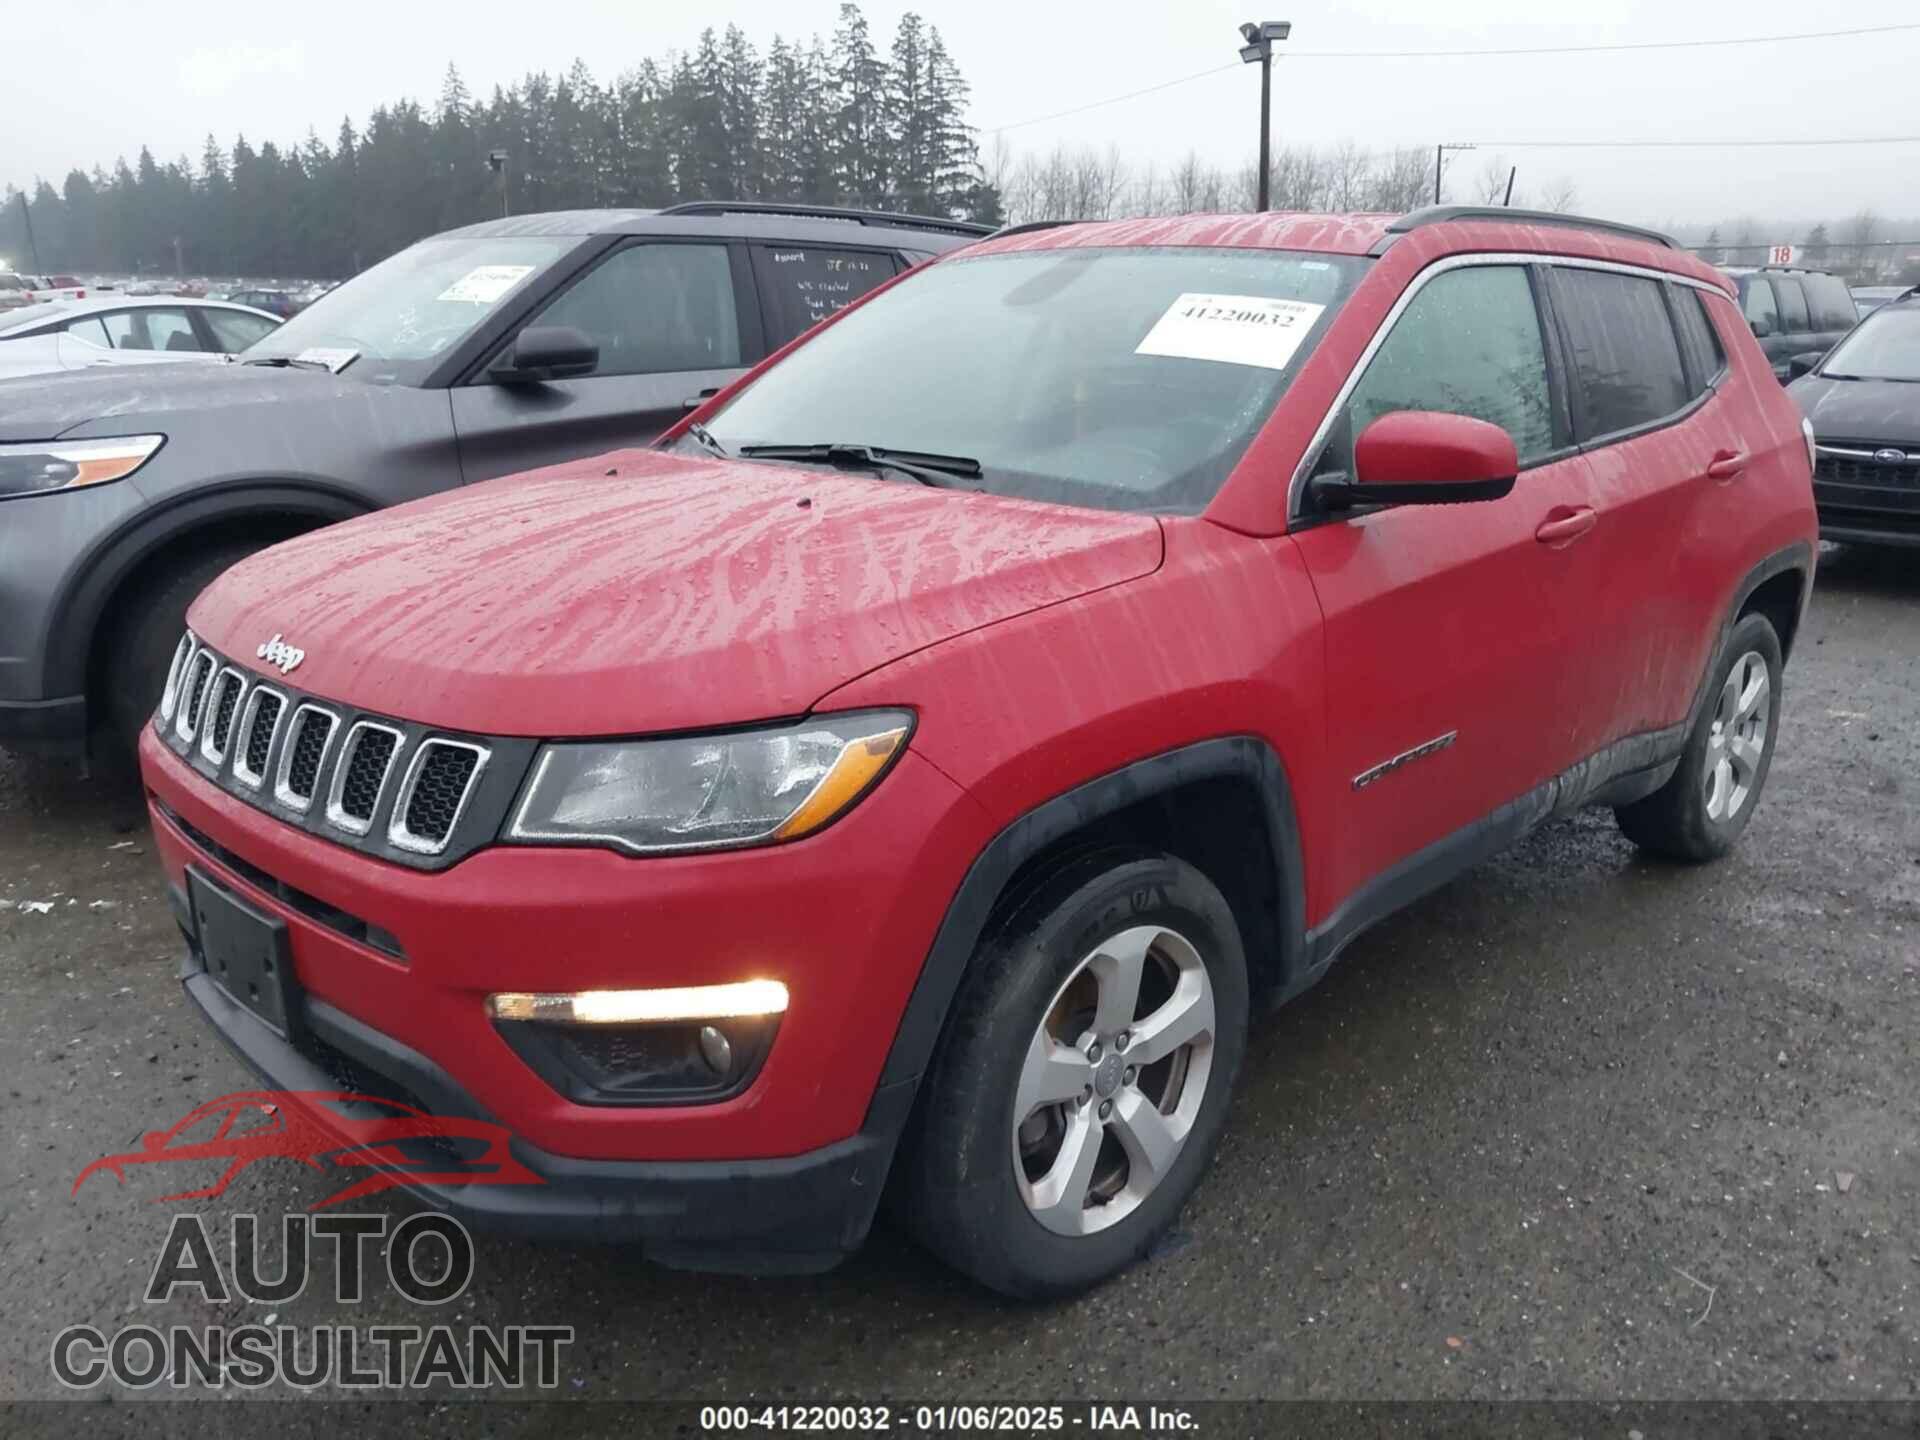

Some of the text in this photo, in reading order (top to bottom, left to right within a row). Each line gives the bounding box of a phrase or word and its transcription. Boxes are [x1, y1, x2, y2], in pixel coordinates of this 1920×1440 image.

[1774, 247, 1791, 263] 18
[1181, 307, 1296, 327] 41220032
[256, 632, 304, 674] Jeep
